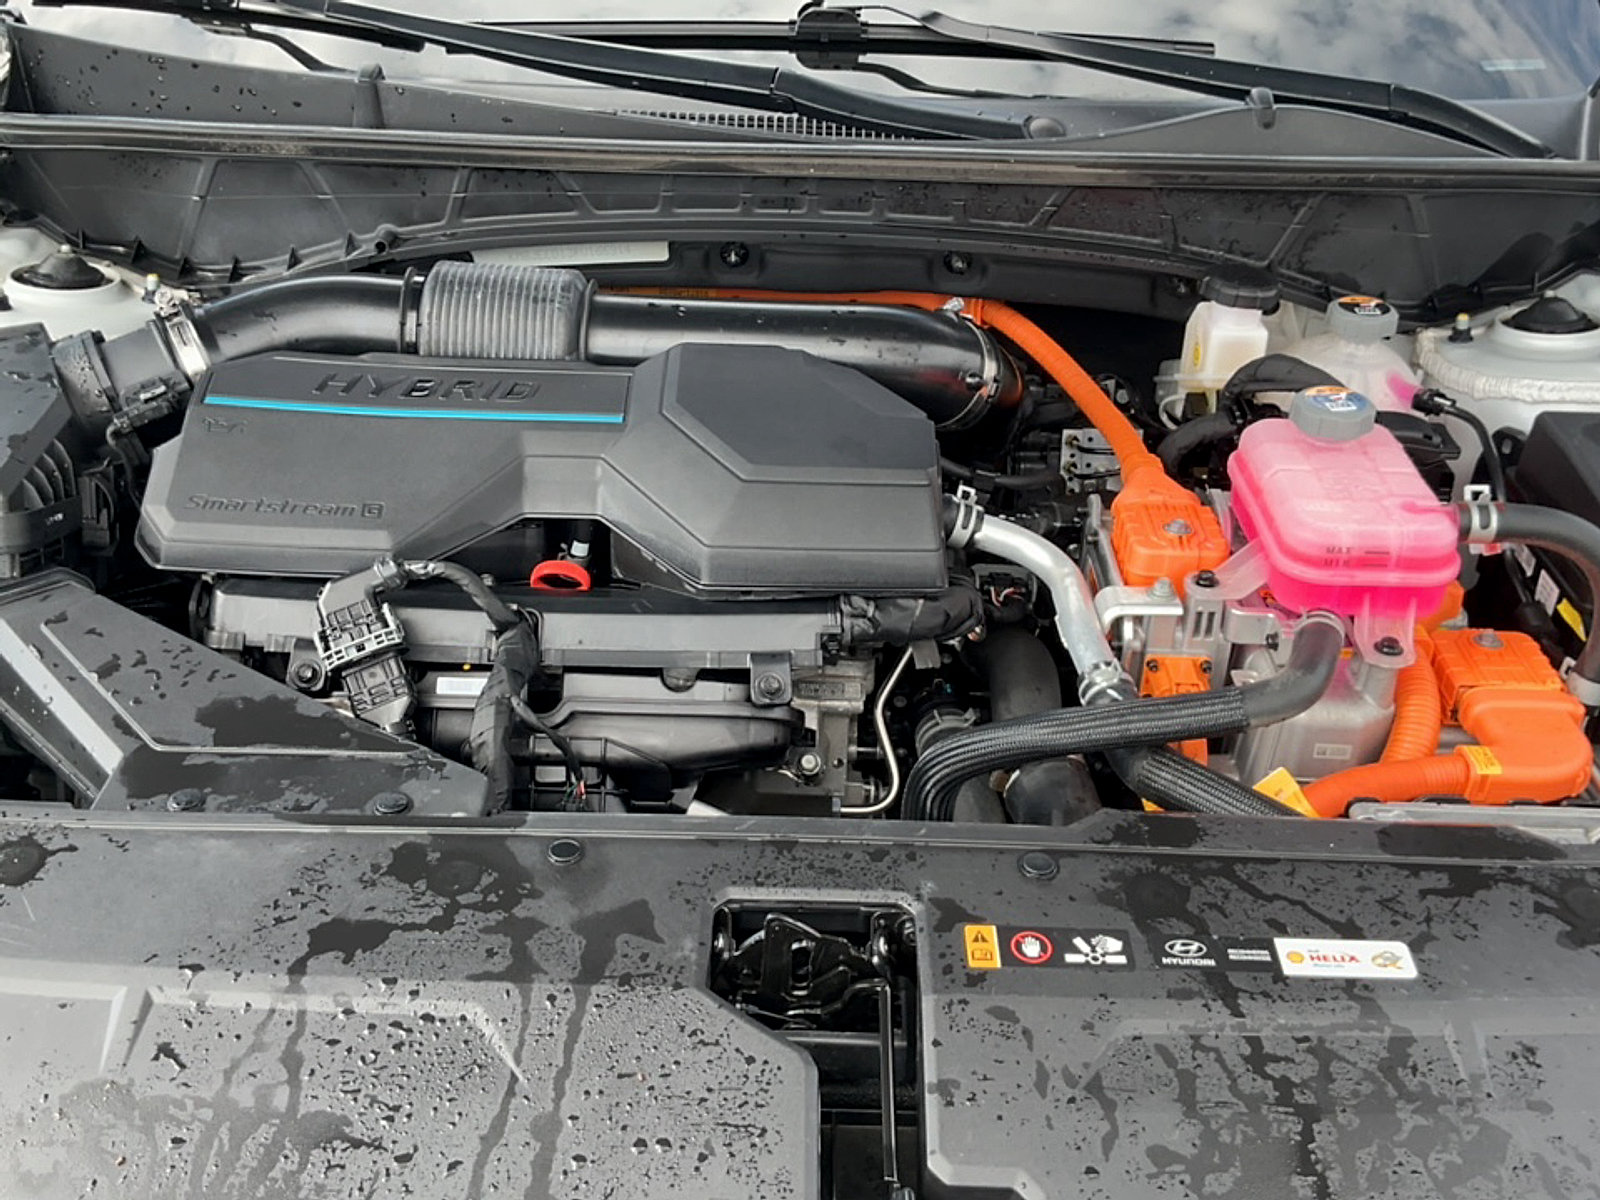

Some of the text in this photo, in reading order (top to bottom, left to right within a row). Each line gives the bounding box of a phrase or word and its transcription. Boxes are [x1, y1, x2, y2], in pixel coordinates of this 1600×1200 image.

[312, 373, 541, 401] HYBRID
[184, 493, 356, 517] Smartstream
[1161, 956, 1217, 967] HYUNDAI
[1308, 952, 1361, 963] HELIX
